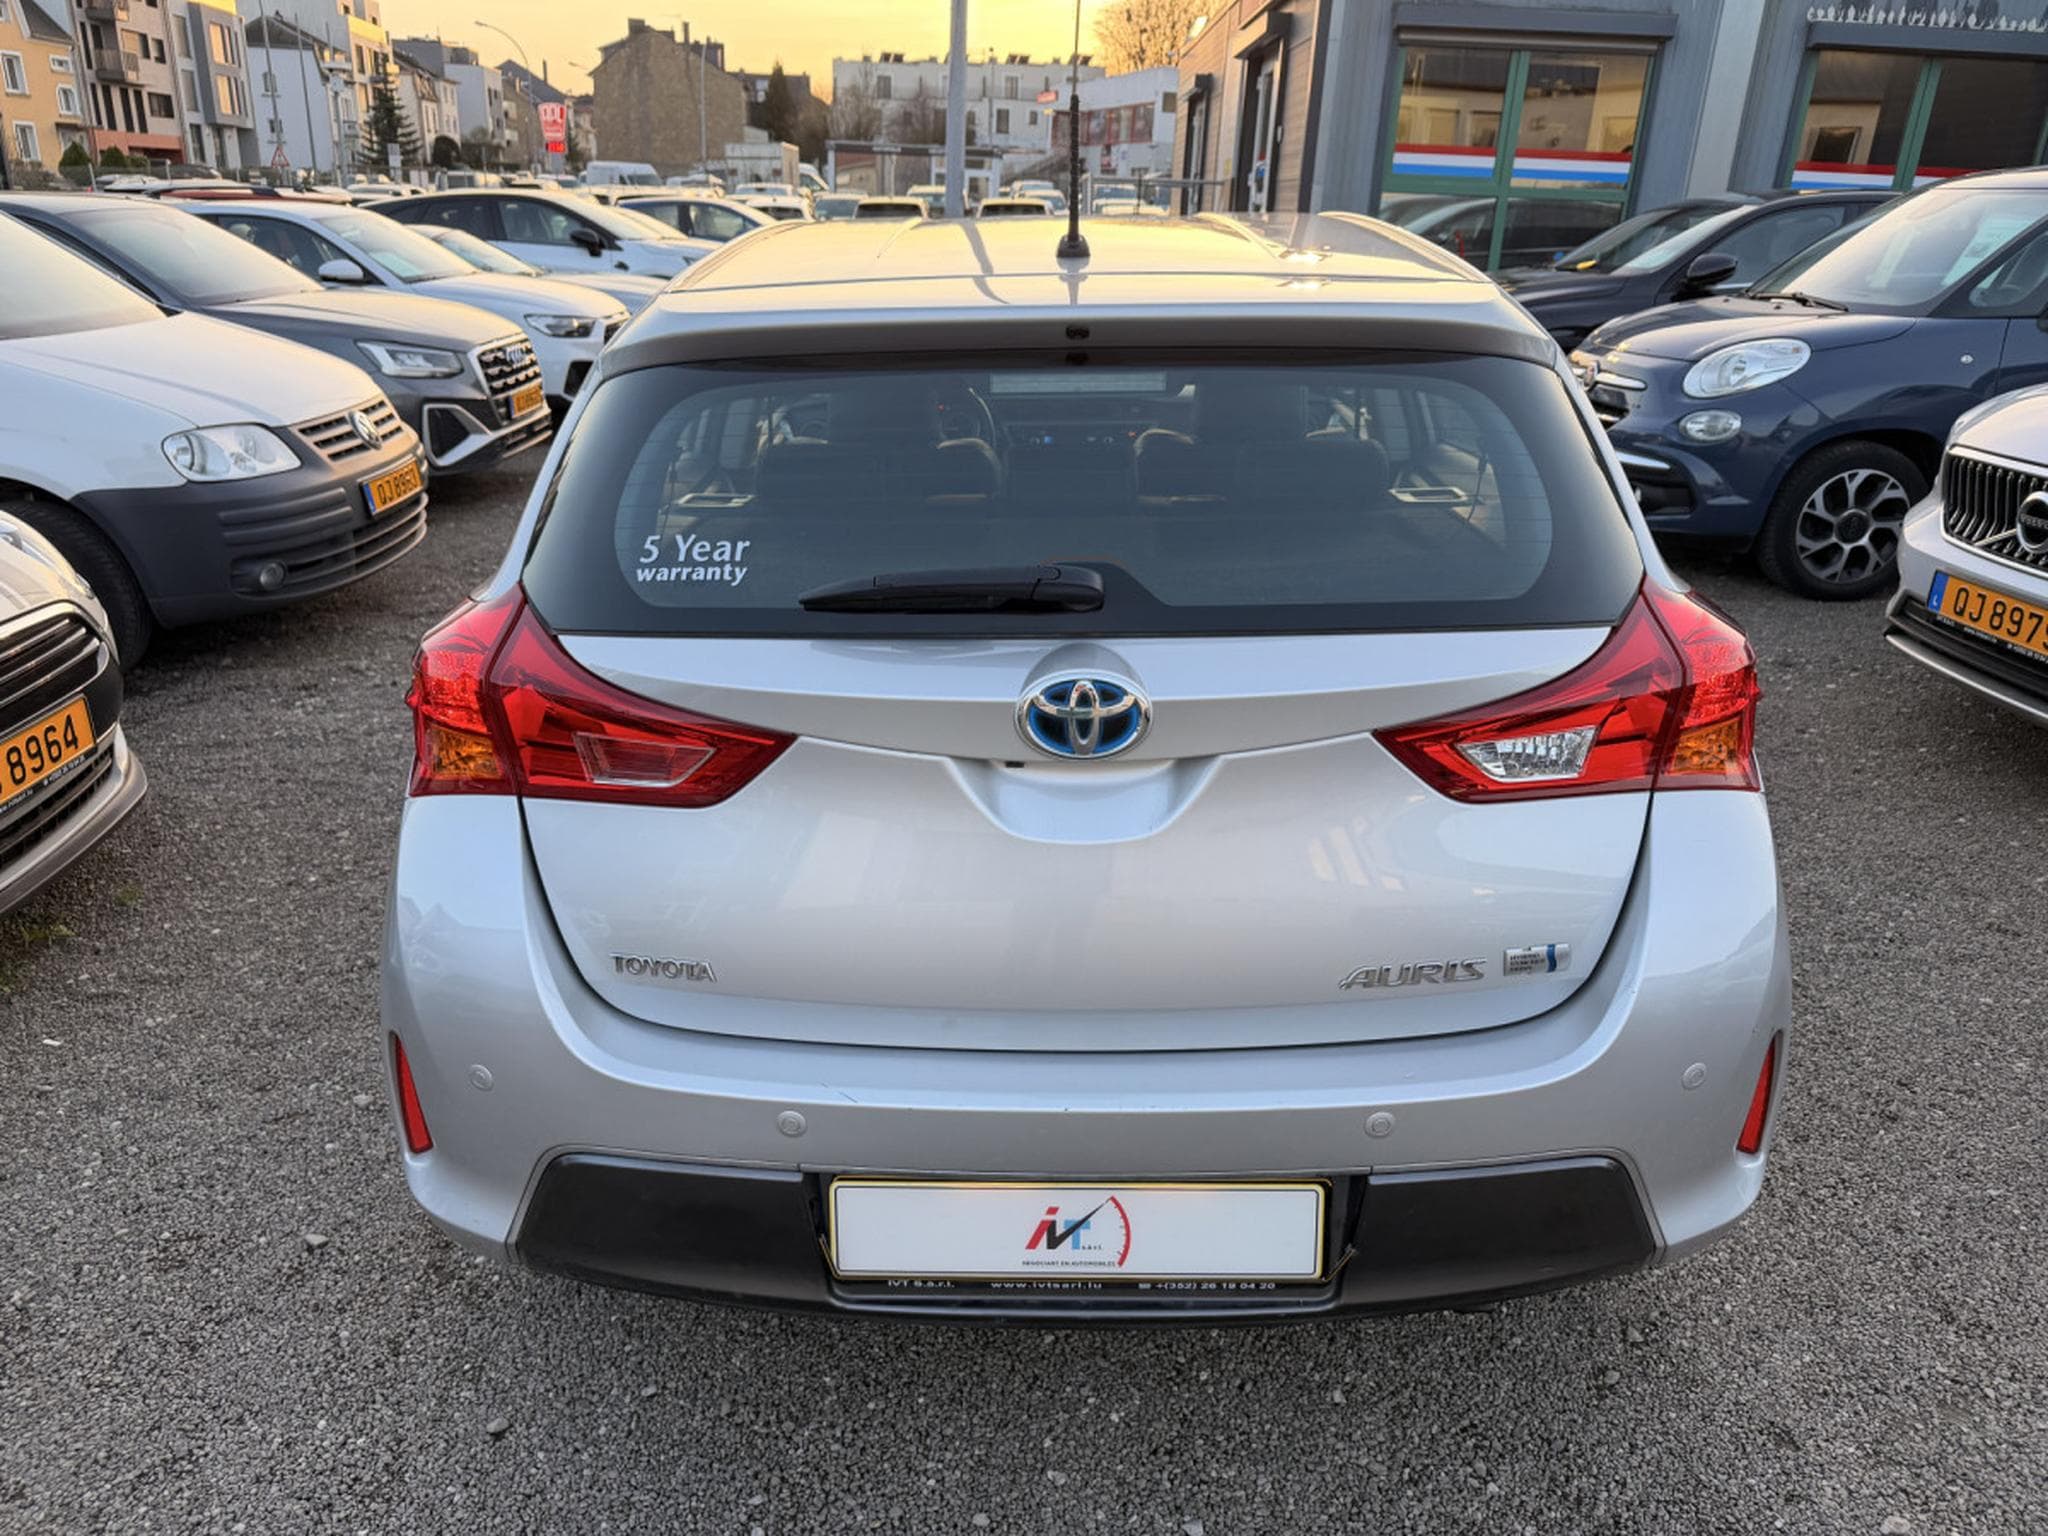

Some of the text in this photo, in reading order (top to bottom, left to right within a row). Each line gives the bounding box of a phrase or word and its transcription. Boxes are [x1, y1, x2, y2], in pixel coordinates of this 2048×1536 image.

[640, 533, 751, 564] 5 Year
[636, 563, 748, 587] warranty
[0, 713, 79, 794] 8964
[609, 953, 718, 982] TOYOTA
[1339, 958, 1488, 990] AURIS
[991, 1281, 1102, 1290] www.ivtsarl.lu
